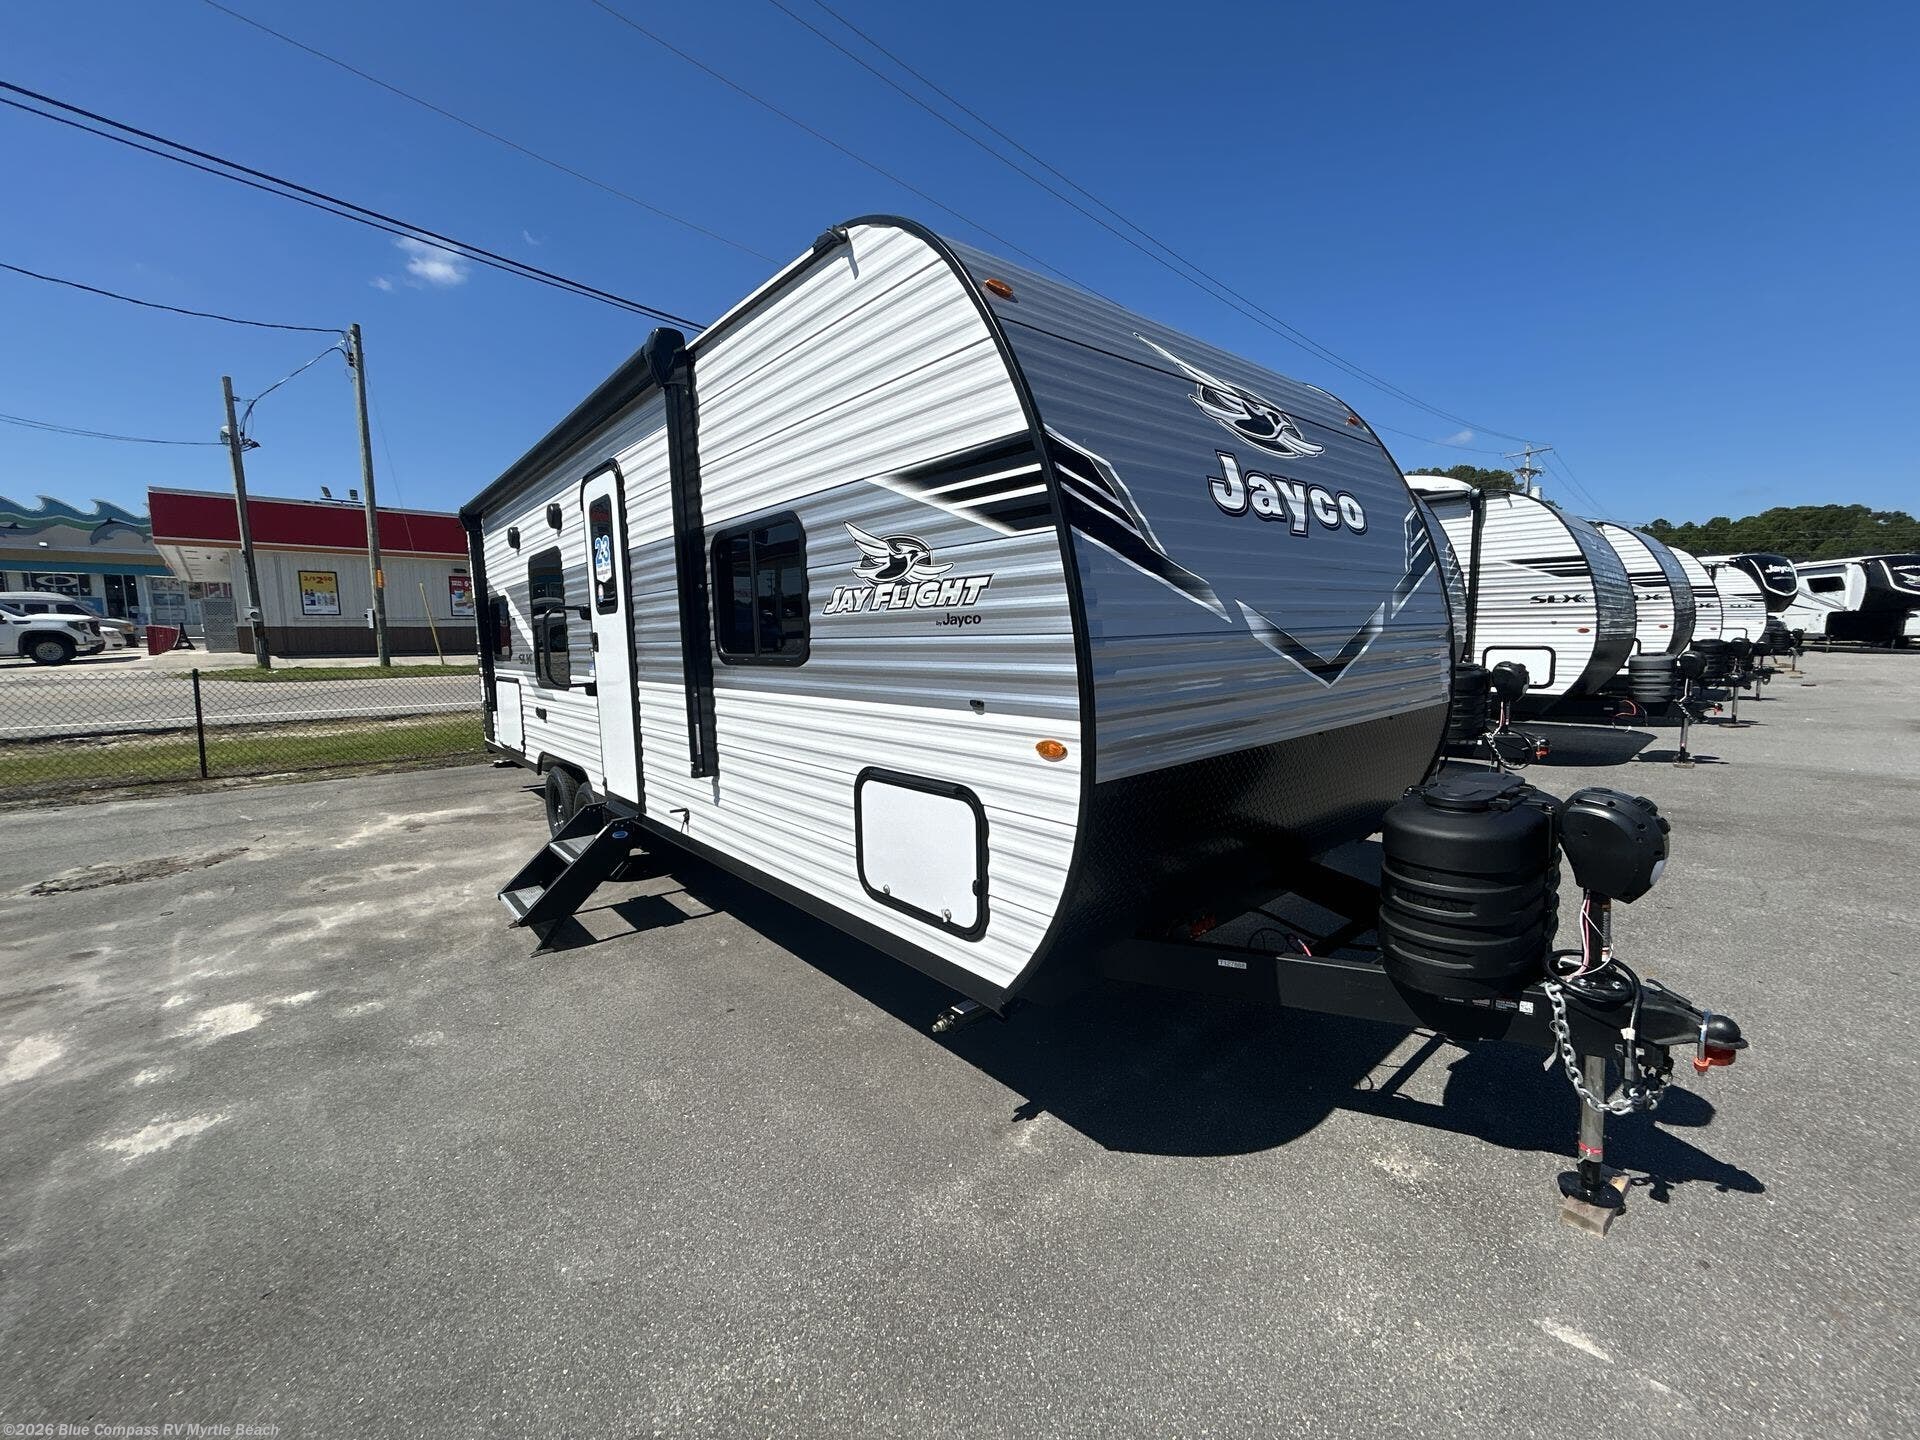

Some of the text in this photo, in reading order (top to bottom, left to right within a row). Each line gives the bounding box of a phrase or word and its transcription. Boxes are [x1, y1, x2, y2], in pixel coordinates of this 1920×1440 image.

[1207, 449, 1368, 537] Jayco
[822, 573, 995, 615] JAY FLIGHT
[1530, 594, 1586, 604] SLX
[942, 613, 982, 628] Jayco
